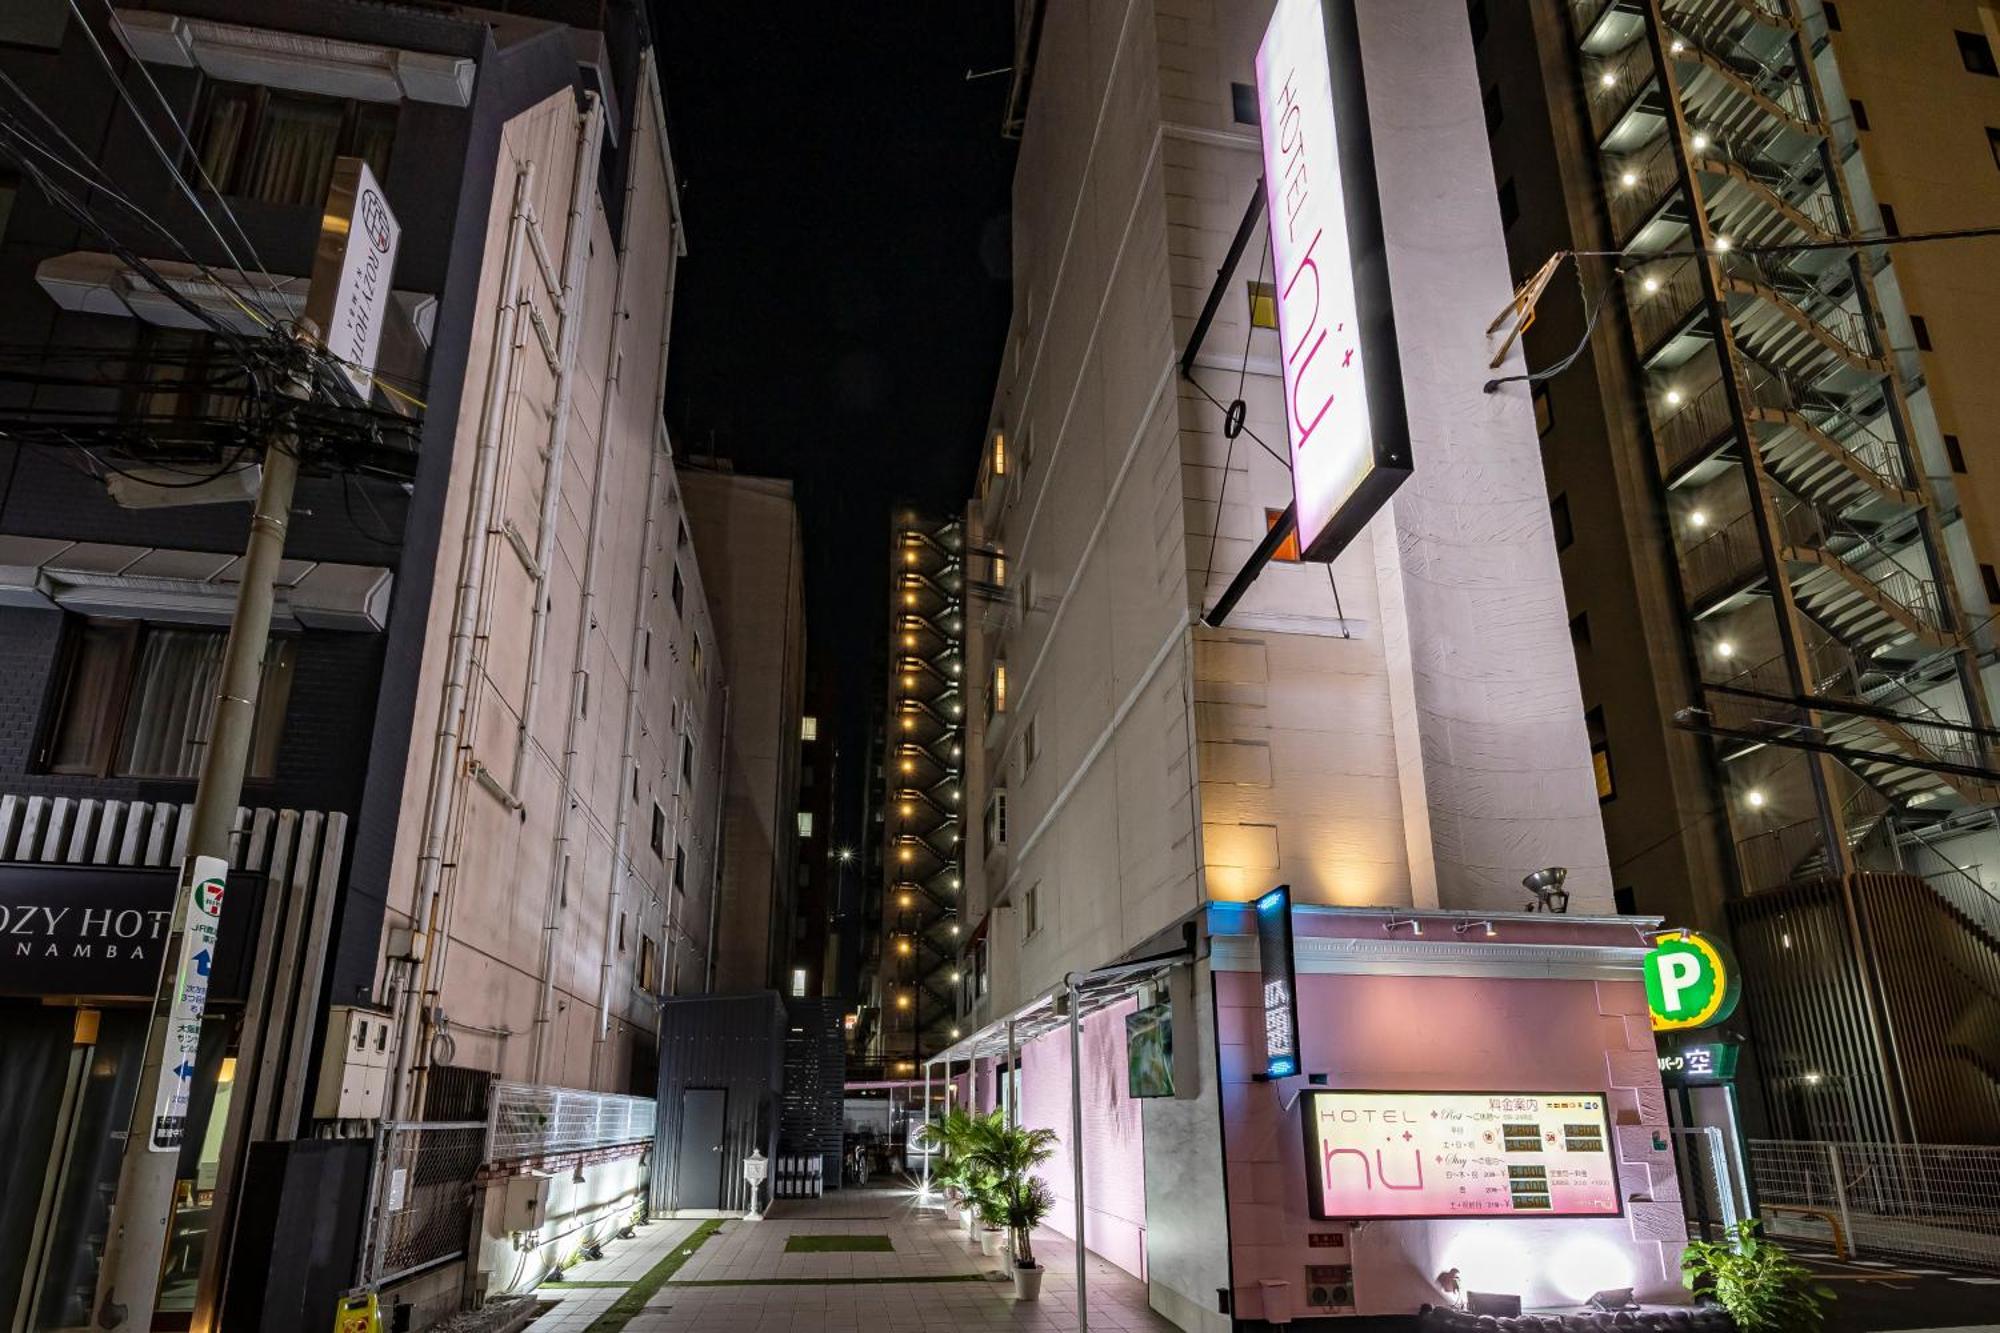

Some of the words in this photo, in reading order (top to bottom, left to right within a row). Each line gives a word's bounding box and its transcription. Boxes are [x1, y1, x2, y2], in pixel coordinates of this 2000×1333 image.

[1276, 66, 1310, 244] HOTEL
[16, 942, 144, 960] NAMBA
[1657, 952, 1701, 1012] P
[1686, 1049, 1713, 1075] 空
[1321, 1109, 1418, 1123] HOTEL
[1489, 1098, 1538, 1112] 料金案内
